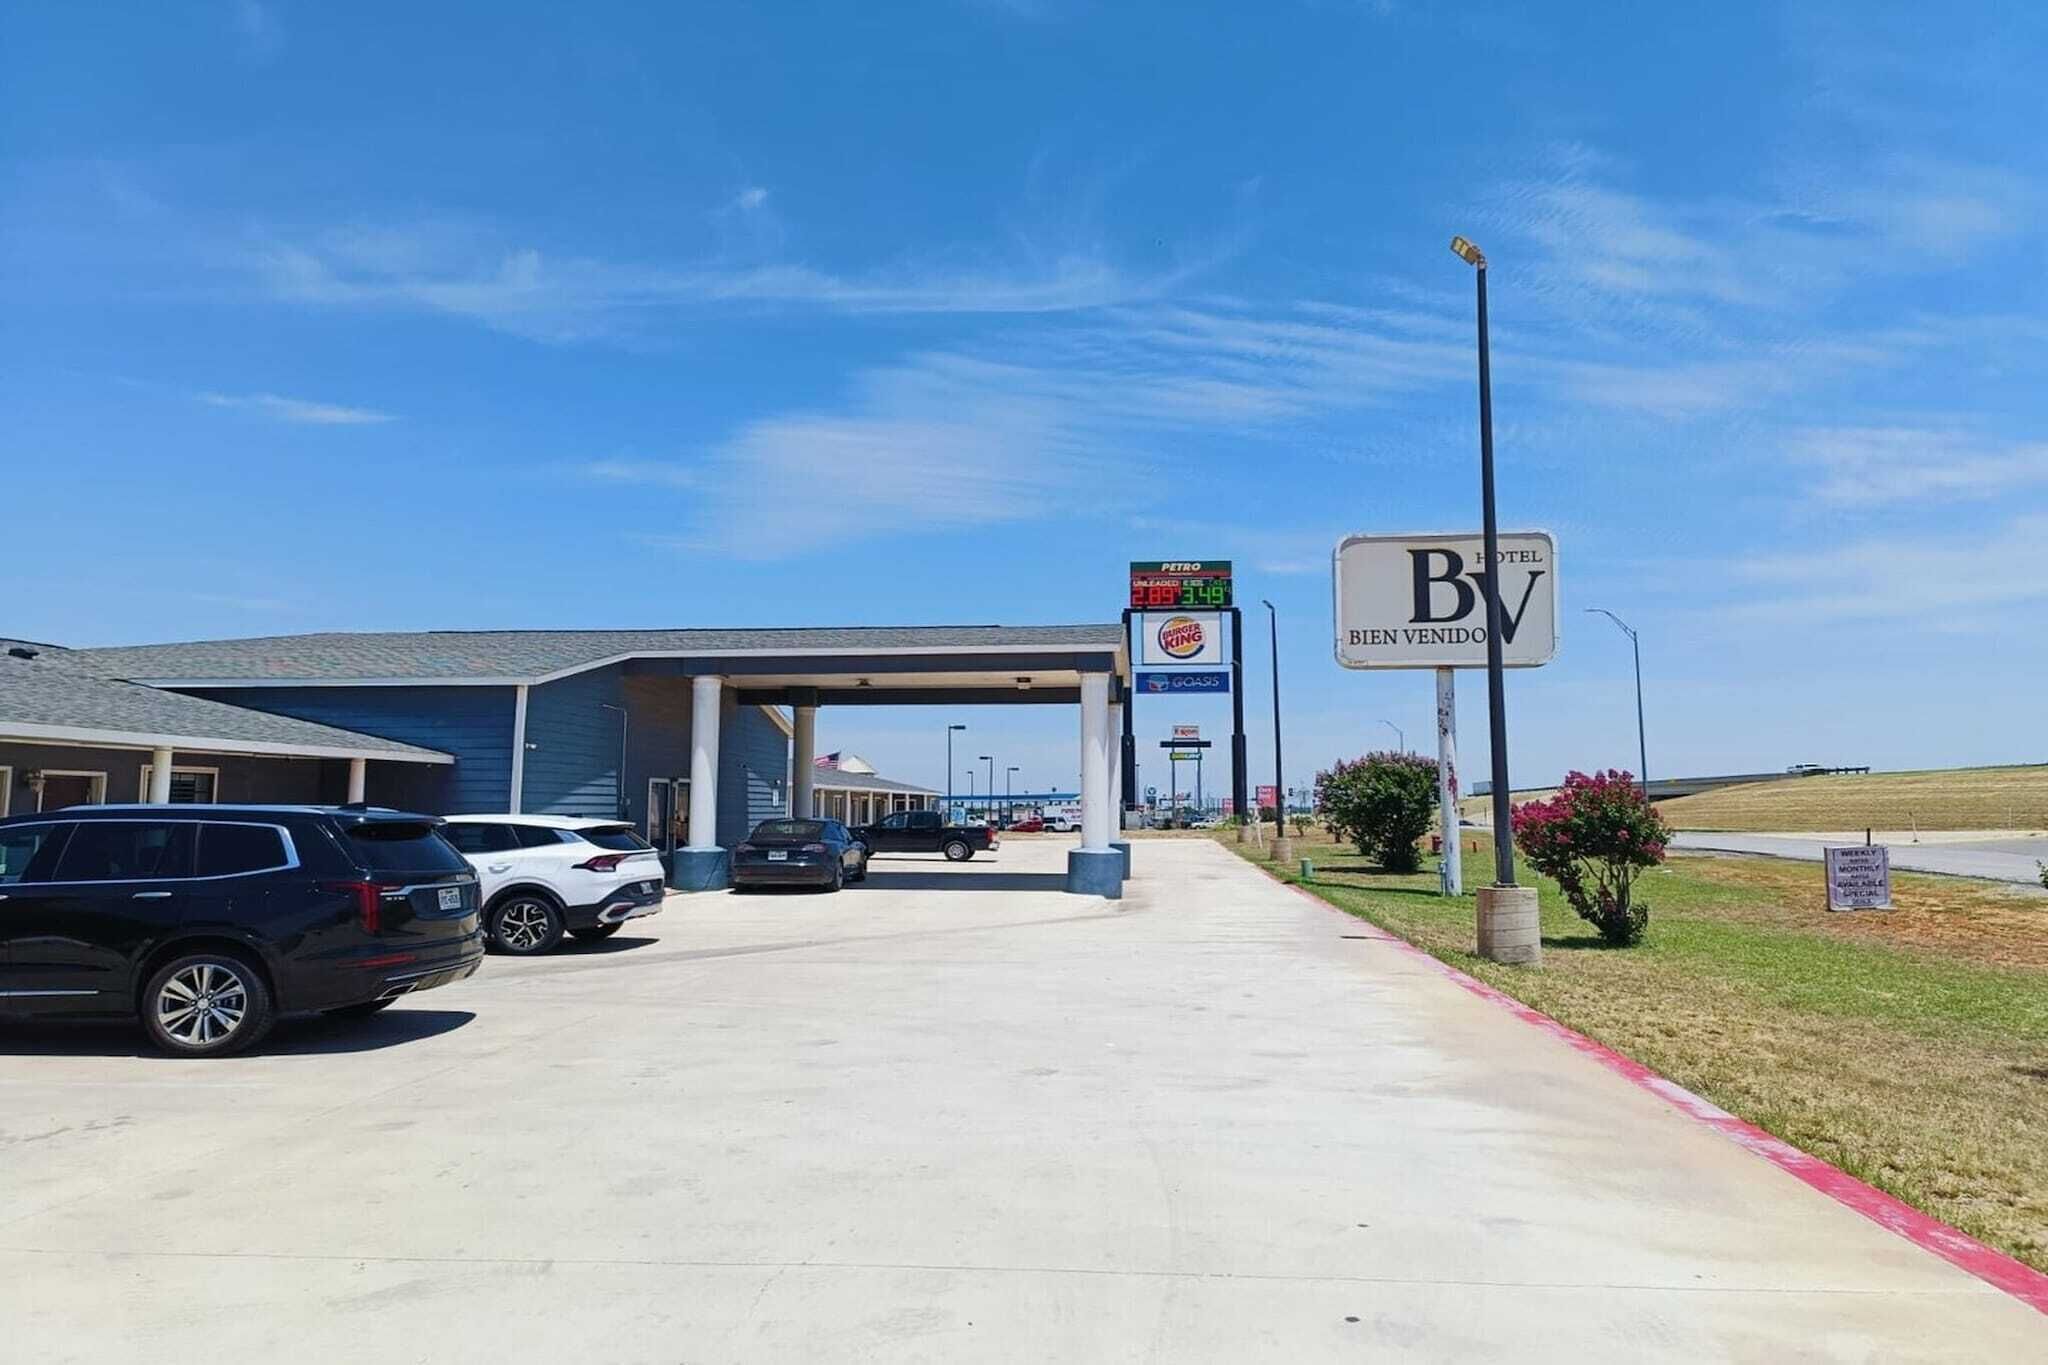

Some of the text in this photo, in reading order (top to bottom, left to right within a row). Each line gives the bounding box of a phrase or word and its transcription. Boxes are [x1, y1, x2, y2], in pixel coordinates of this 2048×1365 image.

[1161, 563, 1201, 572] PETRO
[1162, 623, 1200, 641] BURGER
[1164, 631, 1203, 650] KING
